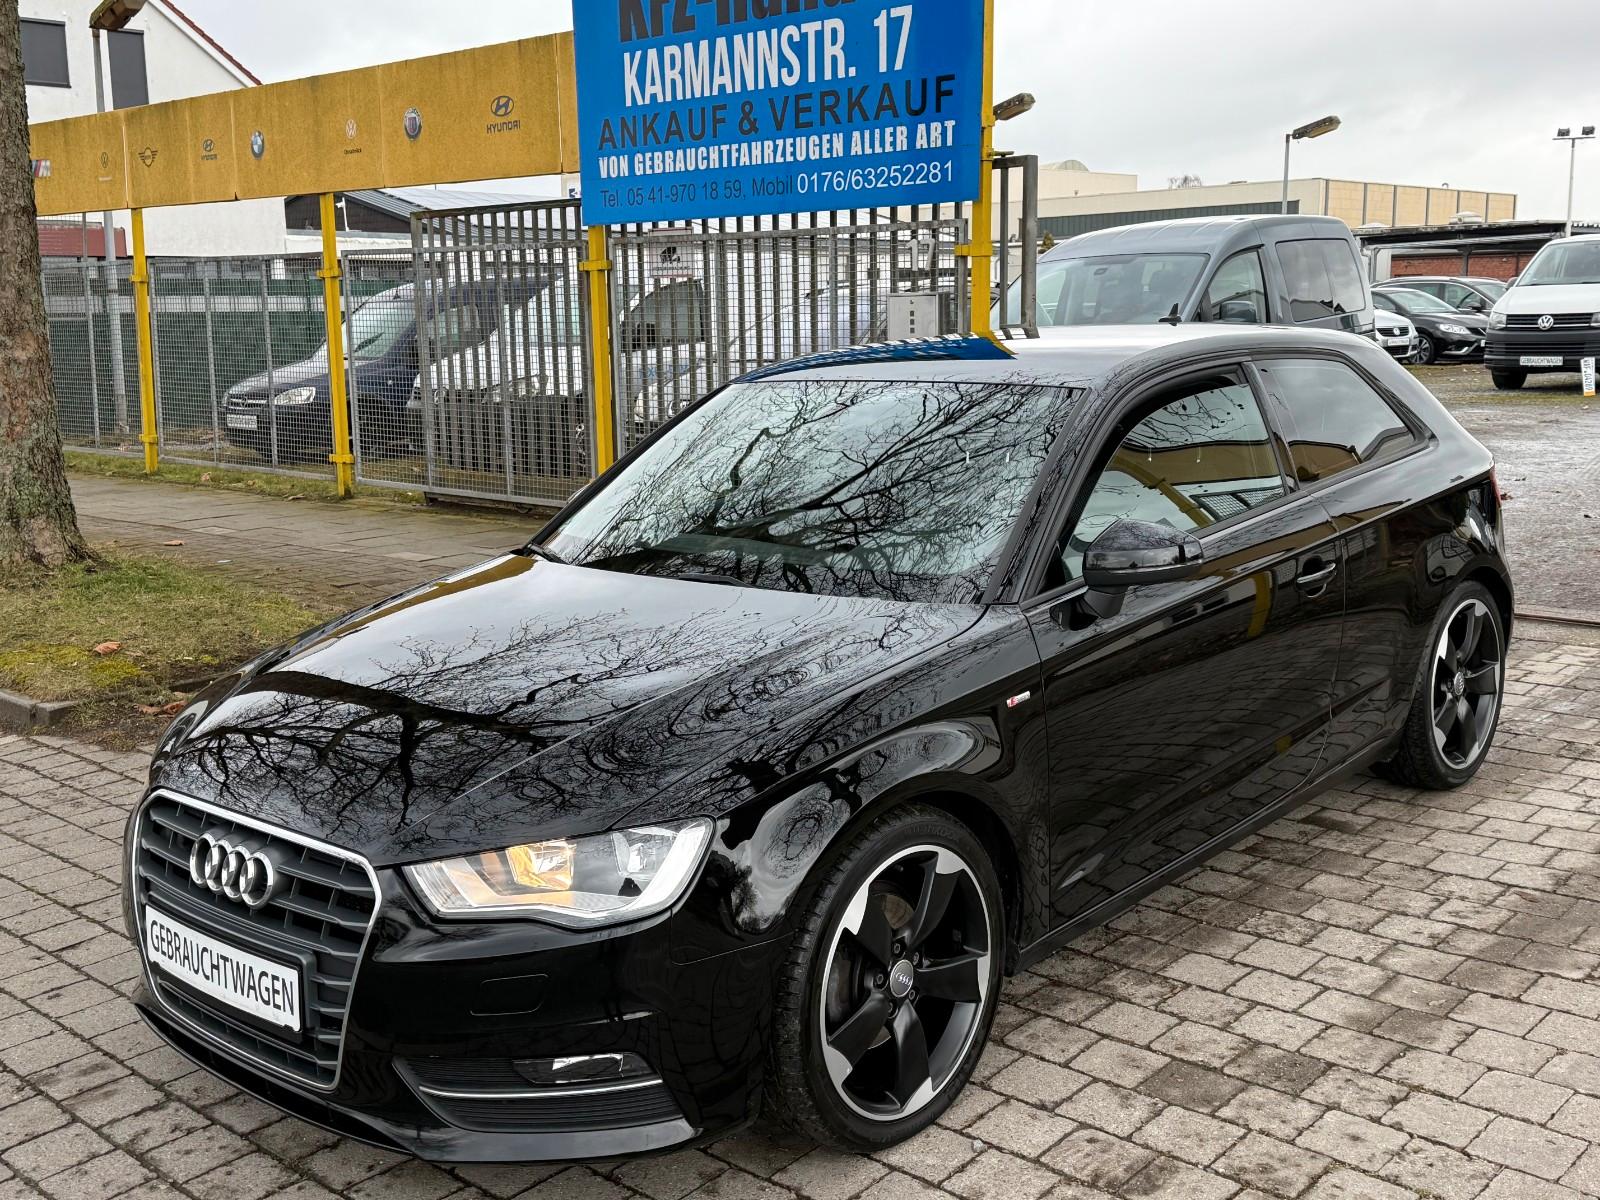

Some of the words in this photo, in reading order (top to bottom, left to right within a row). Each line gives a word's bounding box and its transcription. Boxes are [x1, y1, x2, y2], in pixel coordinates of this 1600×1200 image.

[619, 0, 856, 42] Kfz-
[624, 17, 857, 107] KARMANNSTR.
[874, 5, 913, 73] 17
[486, 120, 520, 134] HYUNDAI
[599, 103, 728, 150] ANKAUF
[738, 100, 759, 136] &
[768, 74, 956, 131] VERKAUF
[599, 154, 629, 179] VON
[634, 132, 844, 176] GEBRAUCHTFAHRZEUGEN
[850, 125, 908, 156] ALLER
[915, 120, 956, 150] ART
[601, 189, 623, 208] Tel.
[702, 181, 719, 200] 18
[752, 174, 793, 197] Mobil
[797, 160, 952, 194] 0176/63252281
[906, 238, 936, 272] 17
[149, 919, 296, 1017] GEBRAUCHTWAGEN
